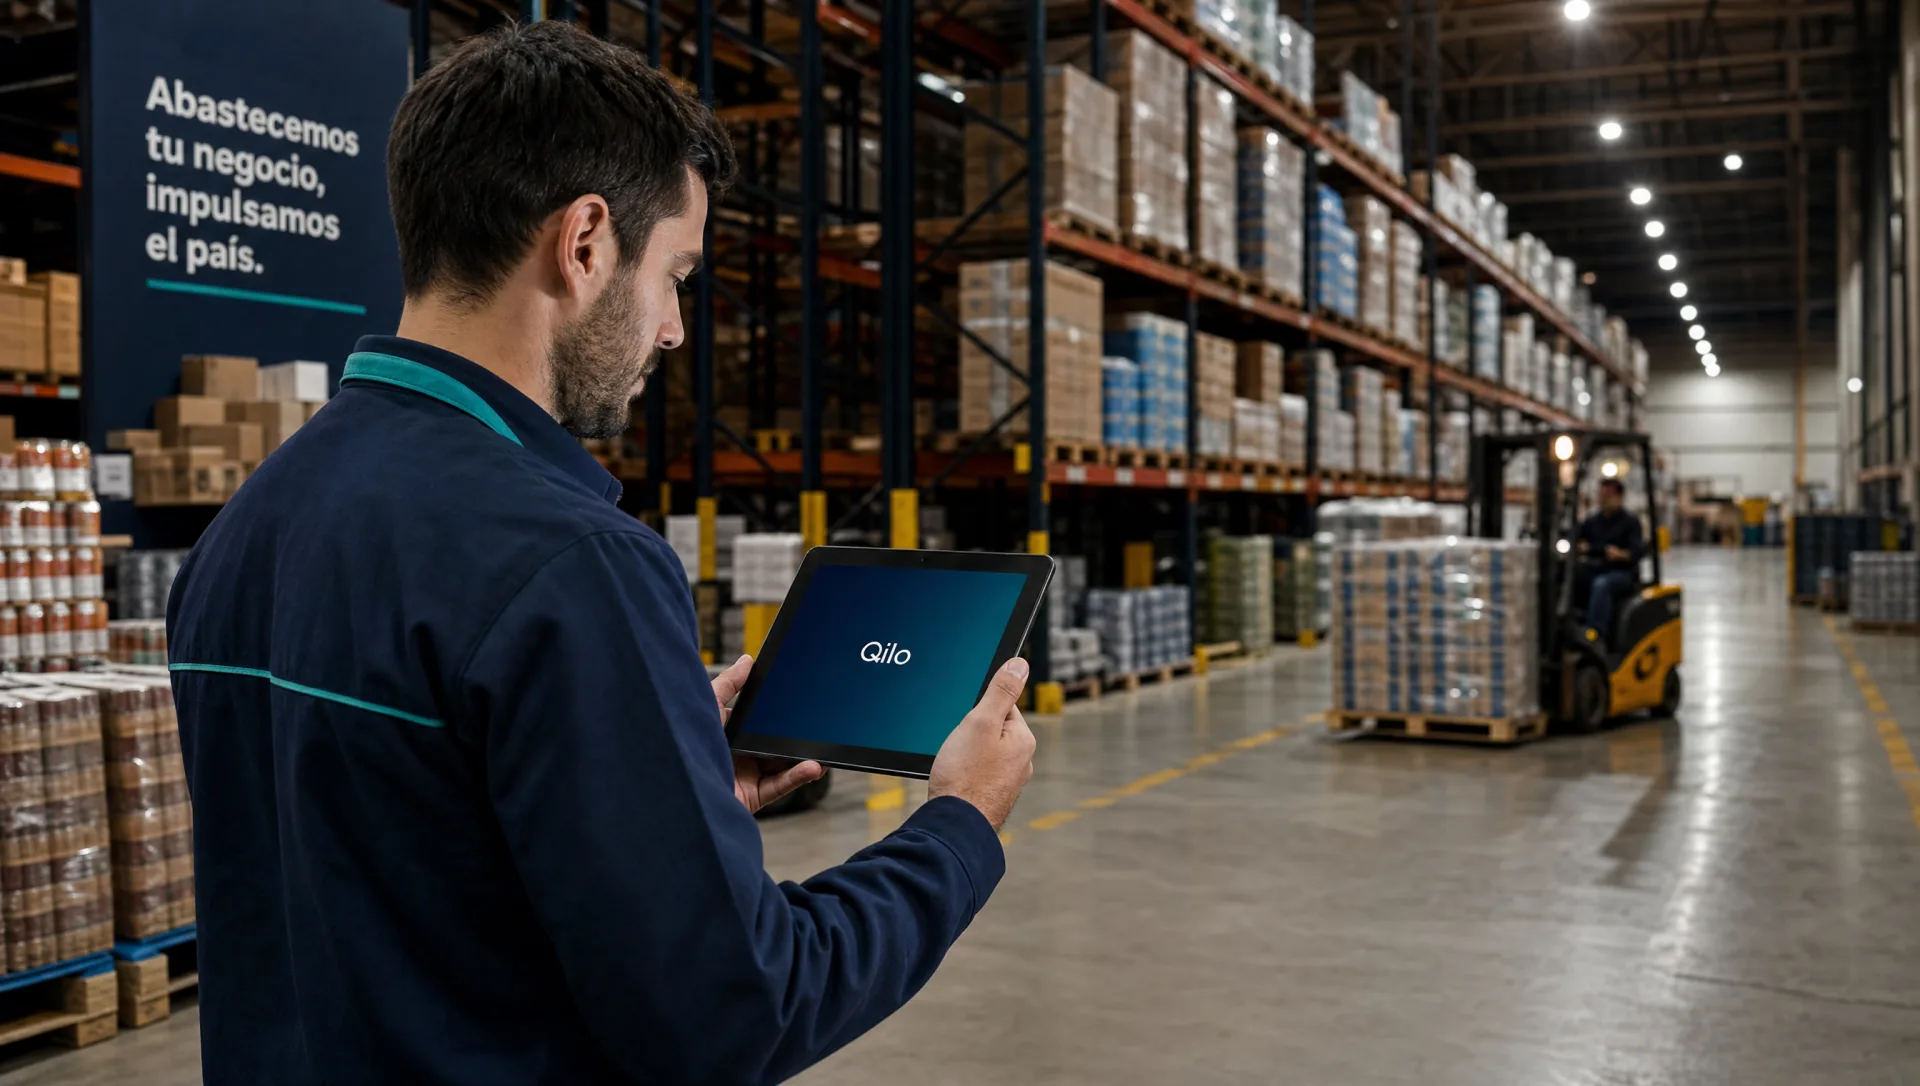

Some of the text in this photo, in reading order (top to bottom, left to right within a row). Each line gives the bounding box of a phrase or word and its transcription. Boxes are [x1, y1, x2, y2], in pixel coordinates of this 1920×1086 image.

[145, 75, 360, 157] Abastecemos
[145, 126, 327, 198] tu negocio,
[146, 173, 341, 241] impulsamos
[145, 225, 264, 274] el país.
[860, 641, 912, 666] Qilo
